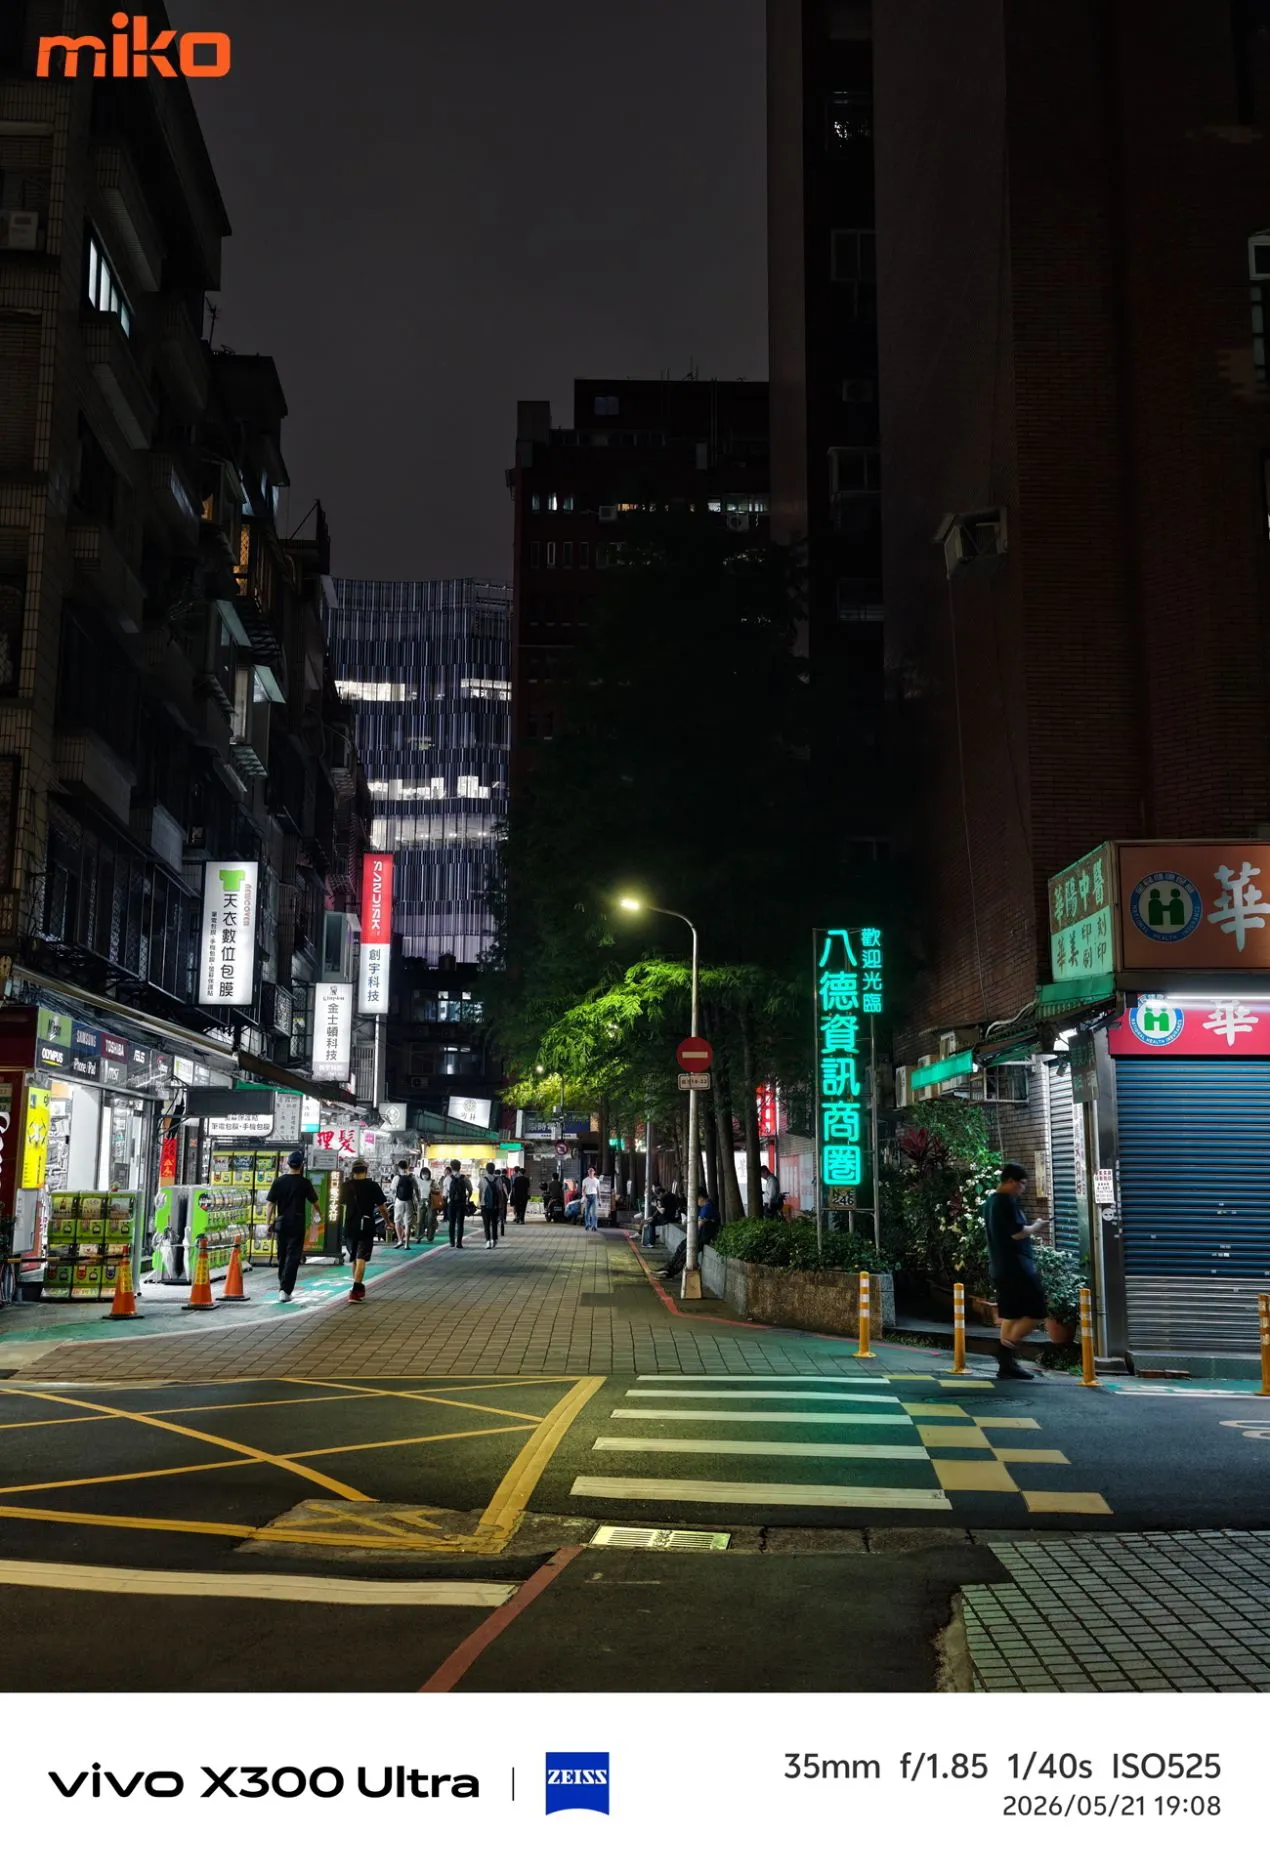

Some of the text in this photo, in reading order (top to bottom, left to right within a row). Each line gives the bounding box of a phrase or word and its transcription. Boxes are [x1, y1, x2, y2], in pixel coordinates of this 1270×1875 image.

[1207, 862, 1270, 952] 華
[219, 893, 238, 997] 天衣數位包膜
[861, 928, 882, 1013] 歡迎光臨
[368, 948, 380, 1002] 創宇科技
[76, 1030, 97, 1047] SAMSUNG
[105, 1039, 124, 1056] TOSHIBA
[326, 1003, 339, 1061] 金士頓科技
[1202, 999, 1259, 1047] 華
[41, 1047, 64, 1063] OLYMPUS
[133, 1049, 146, 1064] ASUS
[820, 929, 861, 1185] 八德資訊商圈
[317, 1129, 356, 1153] 理髮
